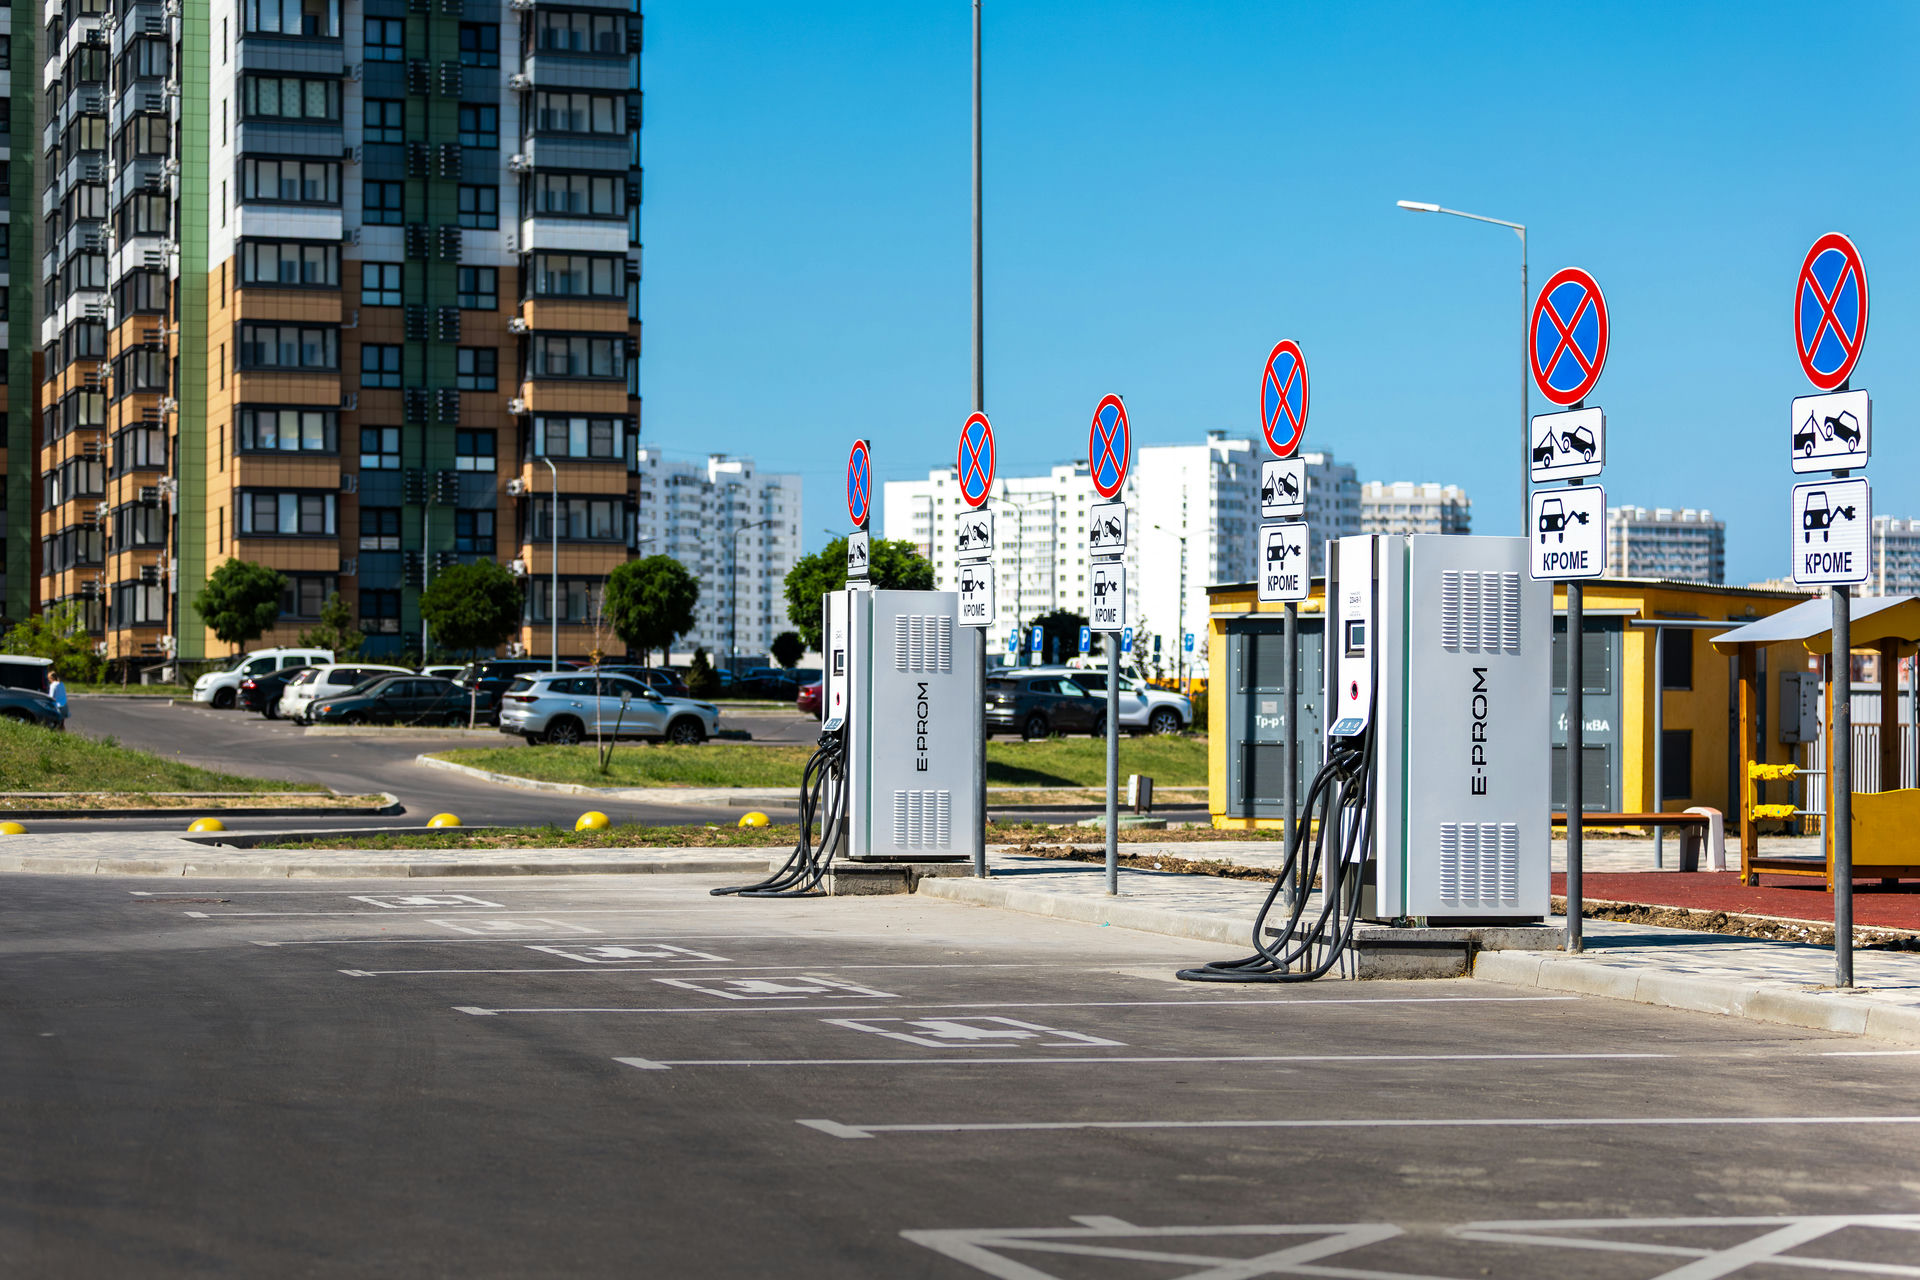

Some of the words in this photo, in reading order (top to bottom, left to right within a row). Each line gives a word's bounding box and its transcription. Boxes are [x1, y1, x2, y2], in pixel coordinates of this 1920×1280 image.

[1543, 550, 1588, 571] КРОМЕ
[1805, 551, 1852, 574] КРОМЕ
[1267, 574, 1299, 591] КРОМЕ
[963, 603, 985, 616] КРОМЕ
[1095, 608, 1116, 622] КРОМЕ
[916, 682, 928, 771] E-PROM
[1472, 667, 1488, 795] E-PROM
